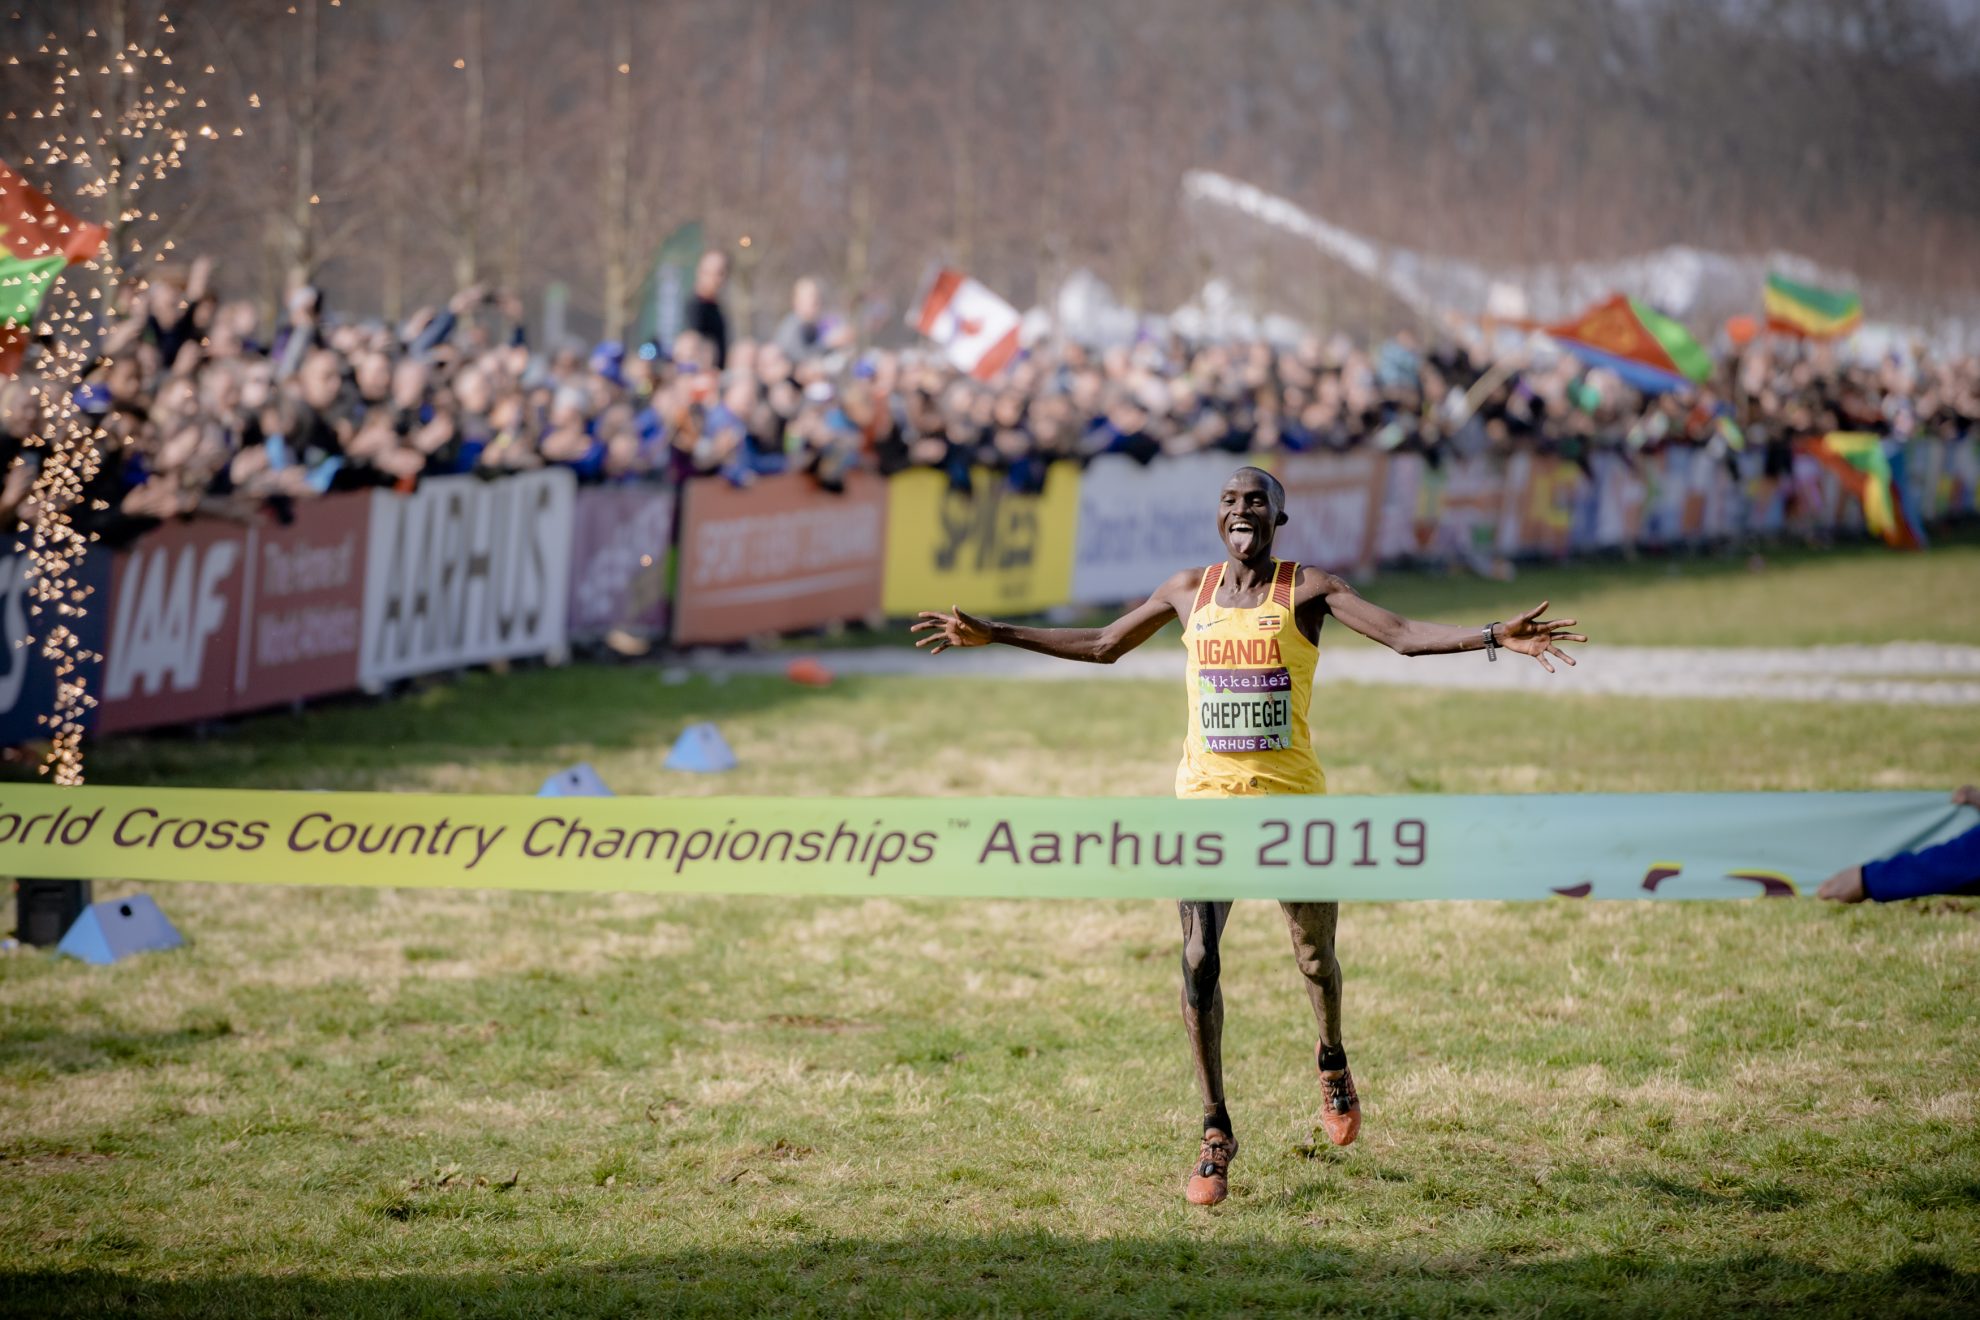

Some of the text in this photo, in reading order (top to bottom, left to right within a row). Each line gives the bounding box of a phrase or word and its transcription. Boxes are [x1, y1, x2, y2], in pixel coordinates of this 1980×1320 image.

[104, 538, 240, 699] IAAF
[1196, 637, 1283, 665] UGANDA
[1200, 675, 1289, 688] Mikkeller
[1201, 700, 1287, 729] CHEPTEGEI
[1205, 738, 1255, 750] AARHUS
[0, 805, 105, 845] orld
[112, 807, 270, 851] Cross
[287, 812, 508, 870] Country
[522, 816, 938, 876] Championships
[978, 820, 1225, 867] Aarhus
[1257, 819, 1427, 867] 2019
